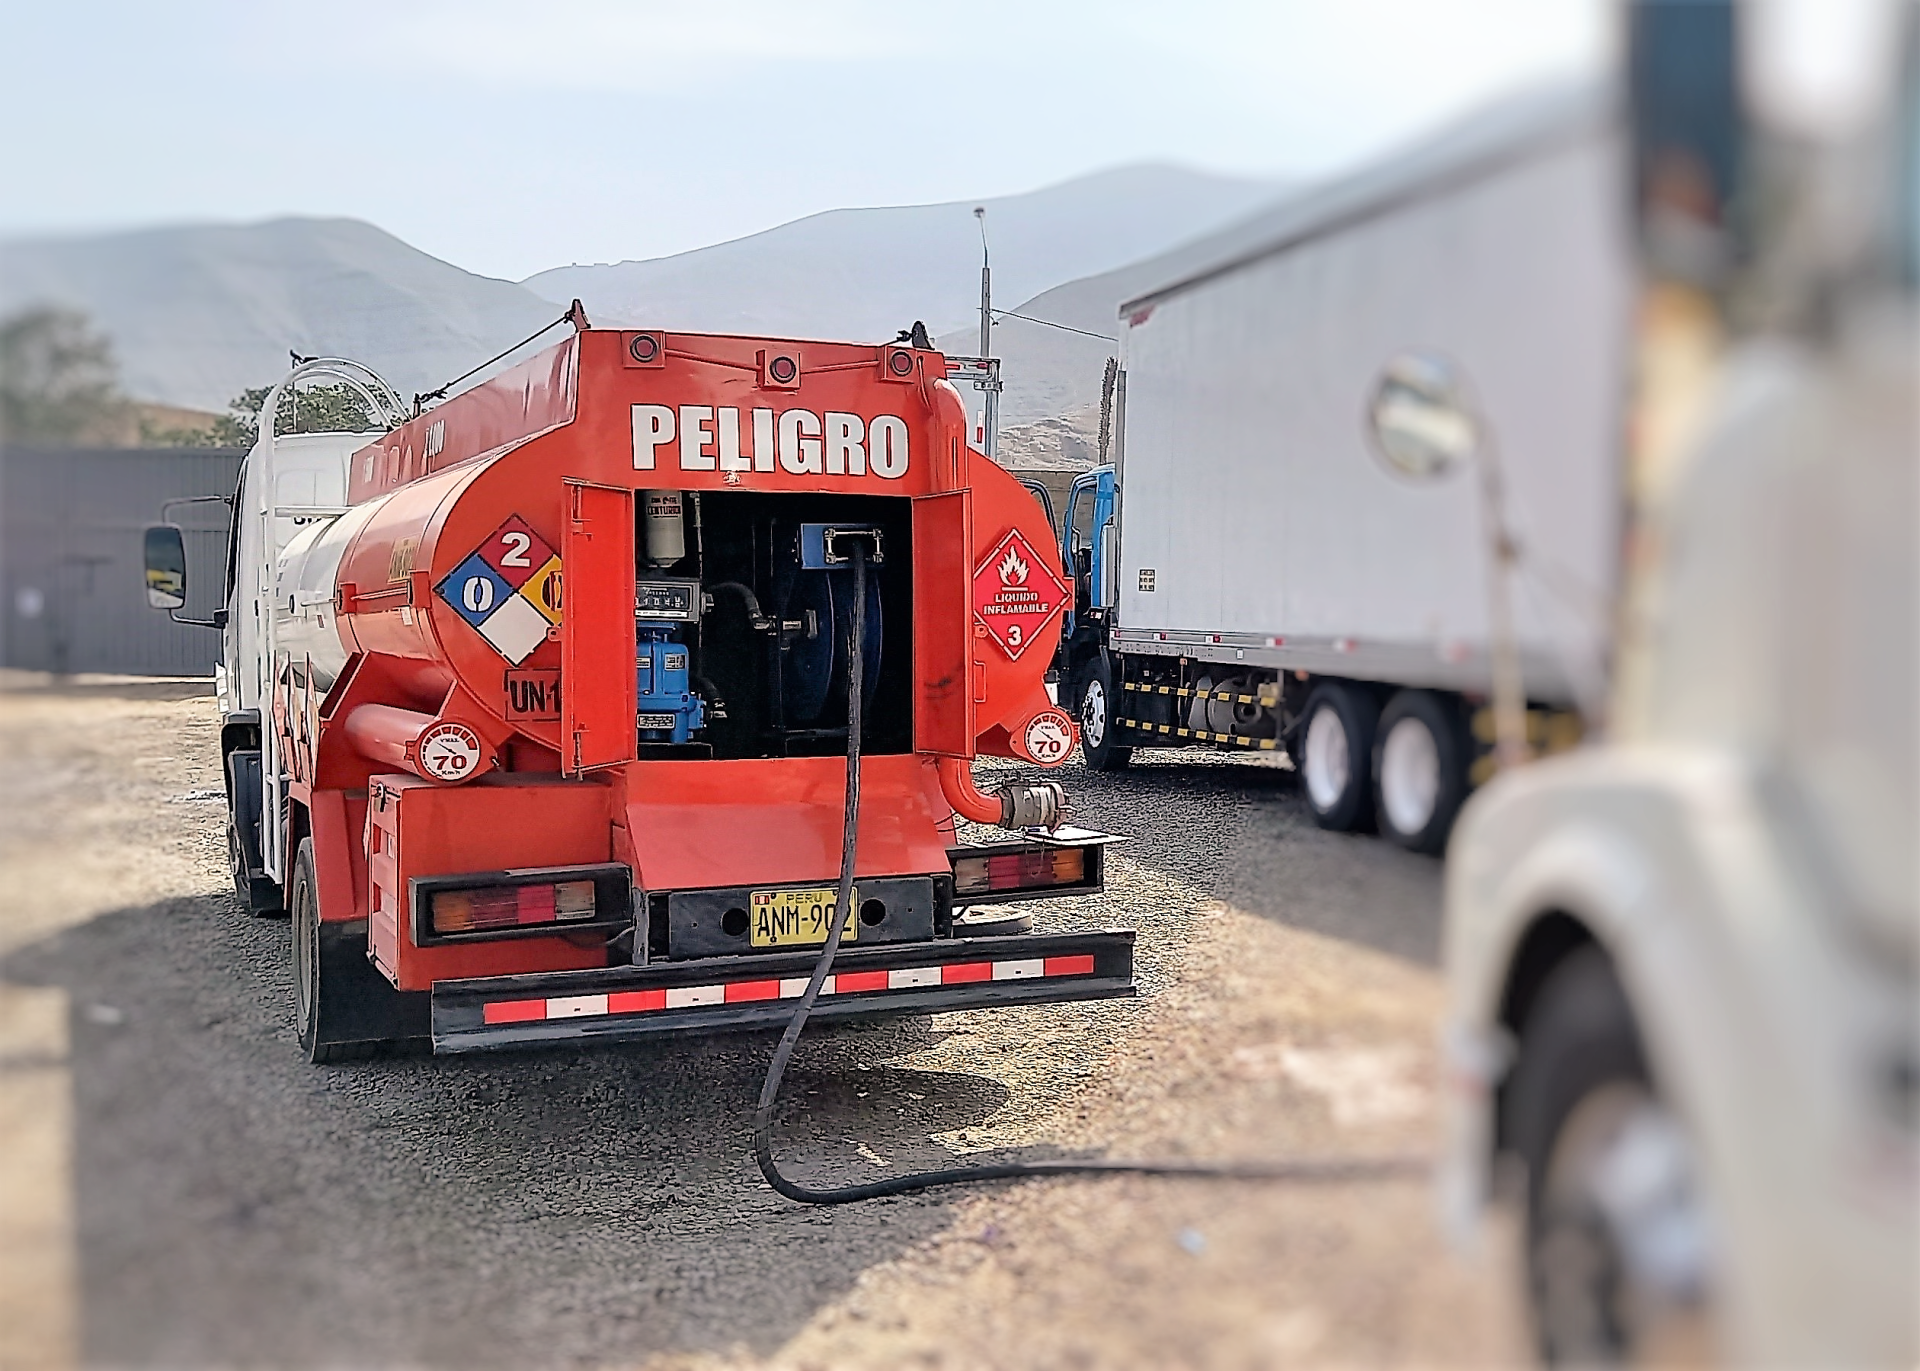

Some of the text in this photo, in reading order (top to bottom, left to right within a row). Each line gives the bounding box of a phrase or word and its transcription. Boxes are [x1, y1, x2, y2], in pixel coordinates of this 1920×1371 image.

[630, 403, 910, 479] PELIGRO
[499, 532, 531, 568] 2
[462, 576, 495, 612] 0
[983, 603, 1049, 615] INFLAMABLE
[1007, 625, 1022, 646] 3
[510, 680, 561, 713] UN-1
[1034, 740, 1061, 753] 70
[433, 755, 467, 770] 70
[786, 892, 823, 904] PERU
